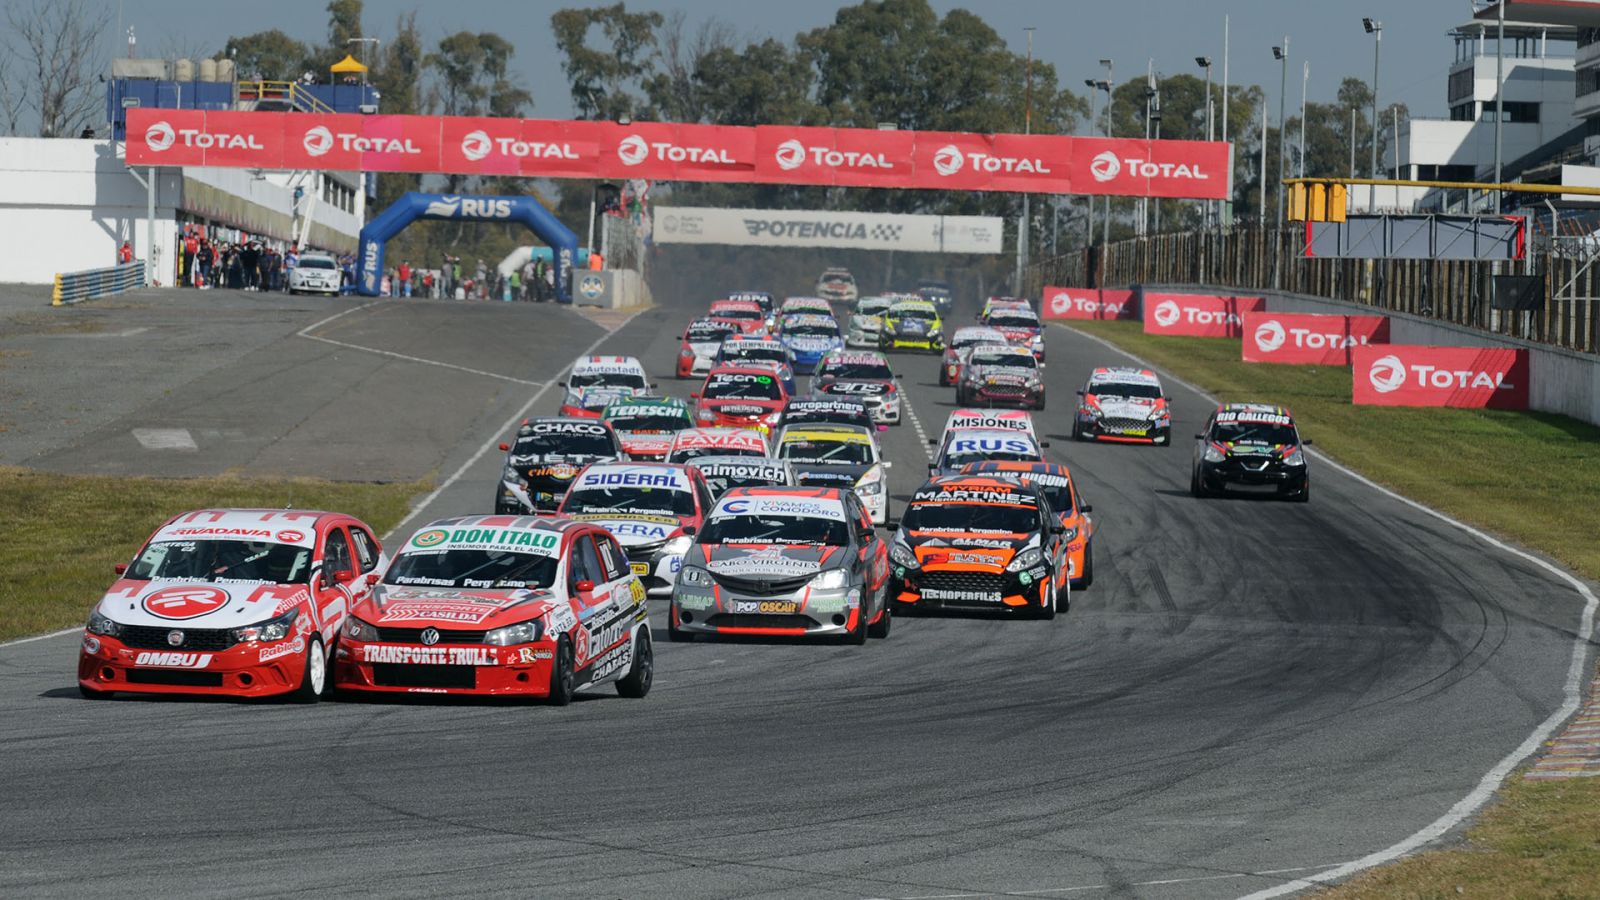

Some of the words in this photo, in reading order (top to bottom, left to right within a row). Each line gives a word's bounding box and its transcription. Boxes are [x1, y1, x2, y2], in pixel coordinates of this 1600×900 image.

[179, 129, 263, 150] TOTAL
[338, 133, 421, 153] TOTAL
[495, 137, 579, 159] TOTAL
[652, 142, 736, 164] TOTAL
[809, 147, 893, 168] TOTAL
[968, 153, 1051, 173] TOTAL
[1125, 159, 1209, 179] TOTAL
[461, 199, 512, 218] RUS
[745, 219, 867, 239] POTENCIA
[364, 242, 378, 271] RUS
[1073, 298, 1129, 313] TOTAL
[1183, 307, 1243, 325] TOTA
[586, 366, 641, 375] Autostadt
[1411, 365, 1514, 389] TOTAL
[609, 406, 684, 418] TEDESCHI
[789, 400, 864, 412] europartners
[953, 418, 1027, 430] MISIONES
[1216, 412, 1236, 421] RIO
[1237, 412, 1290, 424] GALLEGOS
[533, 424, 607, 435] CHACO
[677, 434, 763, 447] FAVIAL
[956, 440, 1028, 452] RUS
[700, 464, 784, 480] aimovich
[584, 473, 682, 488] SIDERAL
[943, 485, 1011, 493] MYRIAM
[915, 491, 1036, 504] MARTINEZ
[763, 501, 821, 509] VIVAMOS
[761, 507, 841, 518] COMODORO
[175, 528, 271, 537] RIVADAVIA
[450, 529, 497, 544] DON
[498, 530, 558, 549] ITALO
[528, 548, 553, 556] AGRO
[710, 559, 748, 568] CABO
[752, 559, 819, 569] VIRGENES
[395, 576, 456, 586] Parabrisas
[281, 589, 308, 611] HUNTER
[394, 603, 489, 613] TRANSPORTE
[759, 602, 797, 614] OSCAR
[419, 611, 479, 621] CASILDA
[136, 652, 196, 666] OMBU
[363, 645, 446, 664] TRANSPORTE
